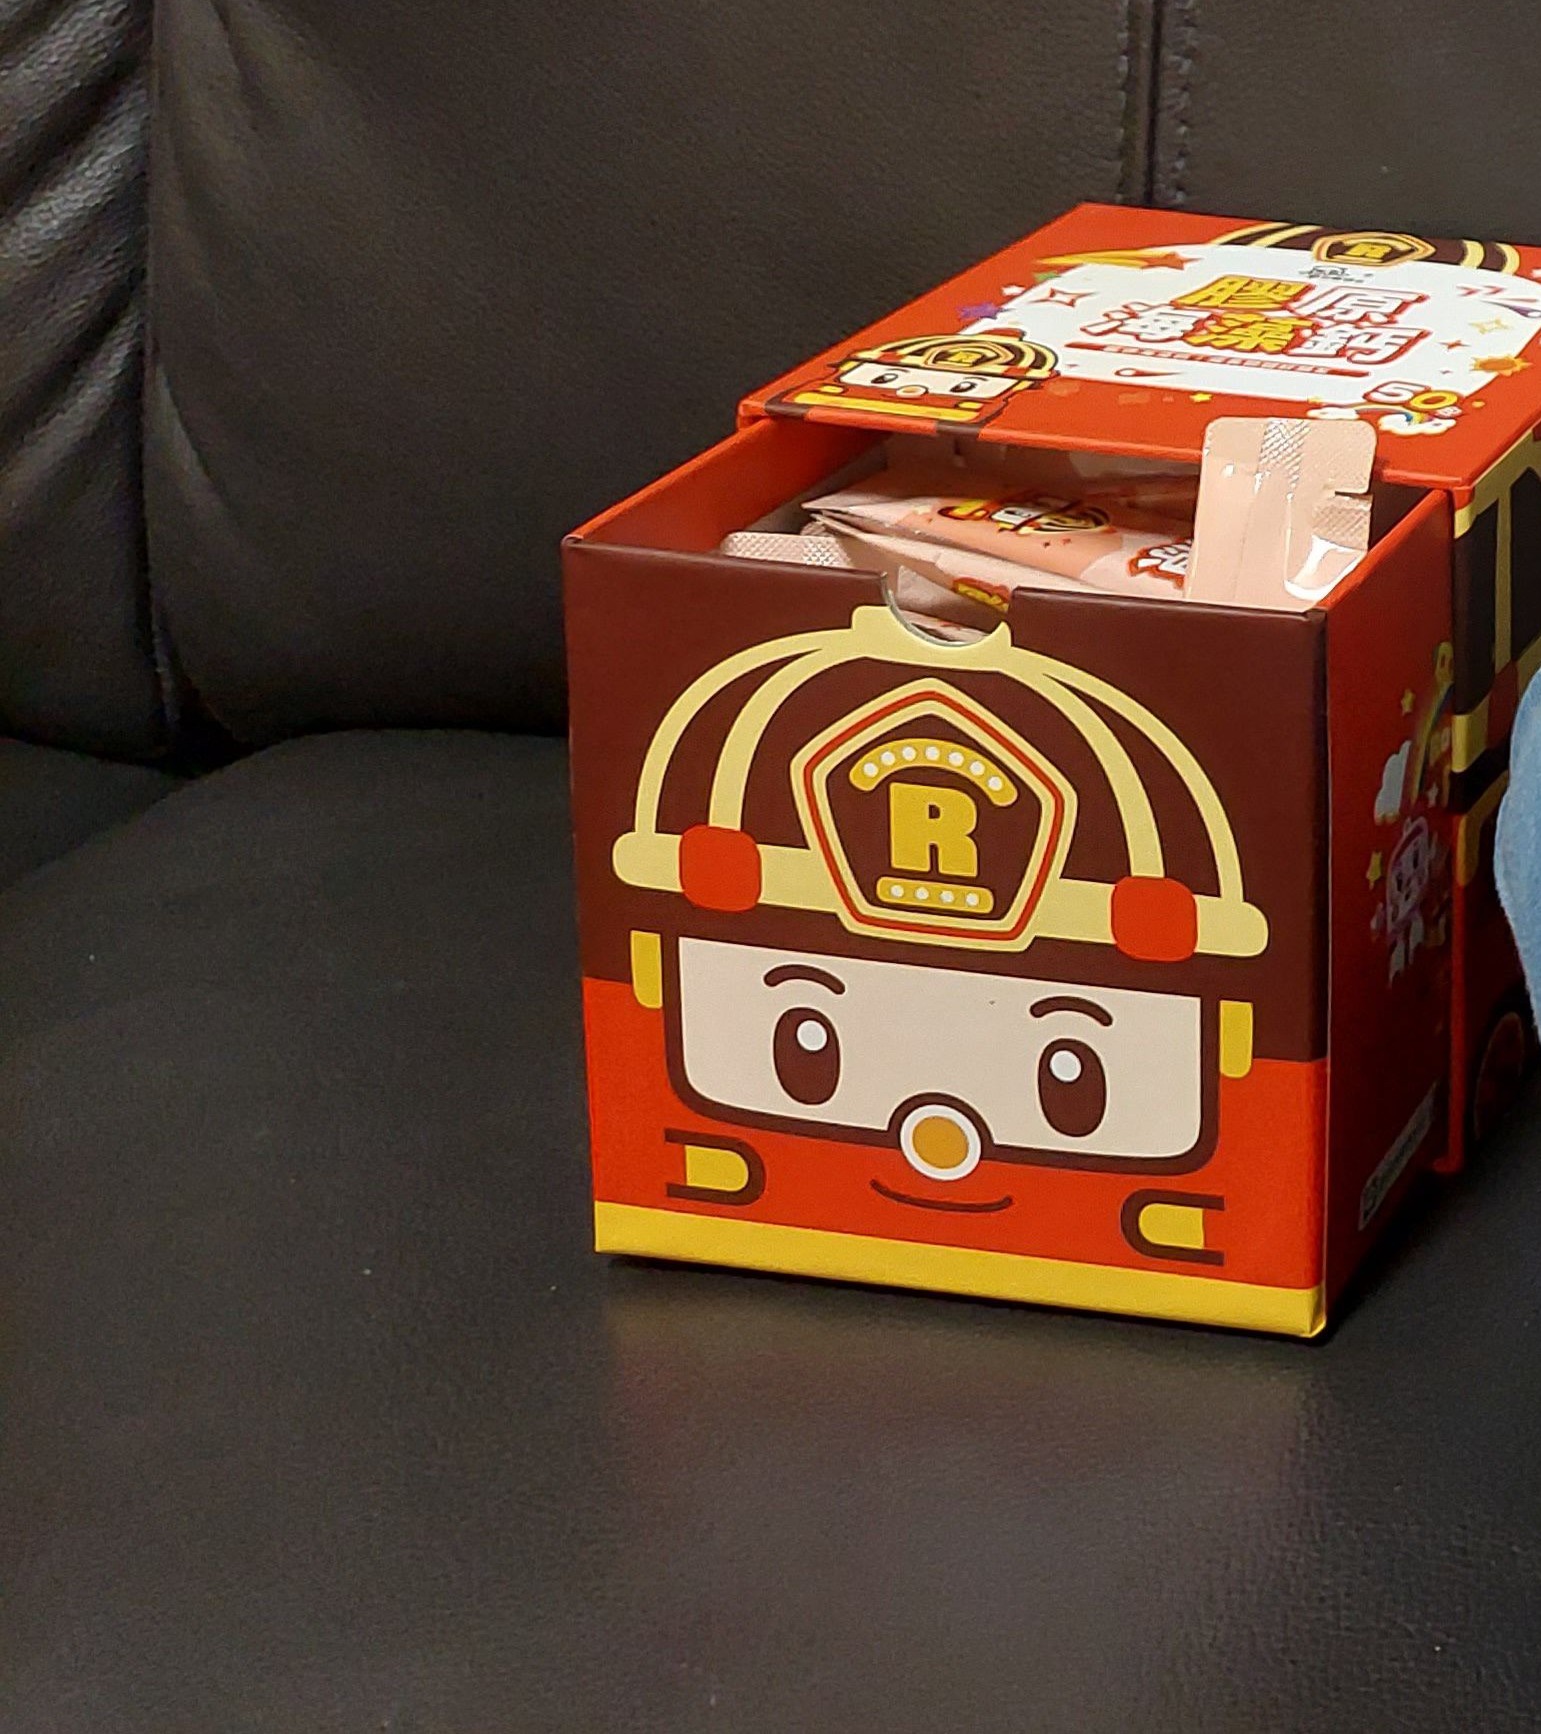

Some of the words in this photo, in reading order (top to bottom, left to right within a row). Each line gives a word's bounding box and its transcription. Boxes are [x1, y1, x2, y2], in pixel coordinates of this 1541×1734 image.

[1170, 274, 1430, 324] 膠原
[1080, 301, 1432, 365] 海藻鈣
[888, 781, 979, 879] R
